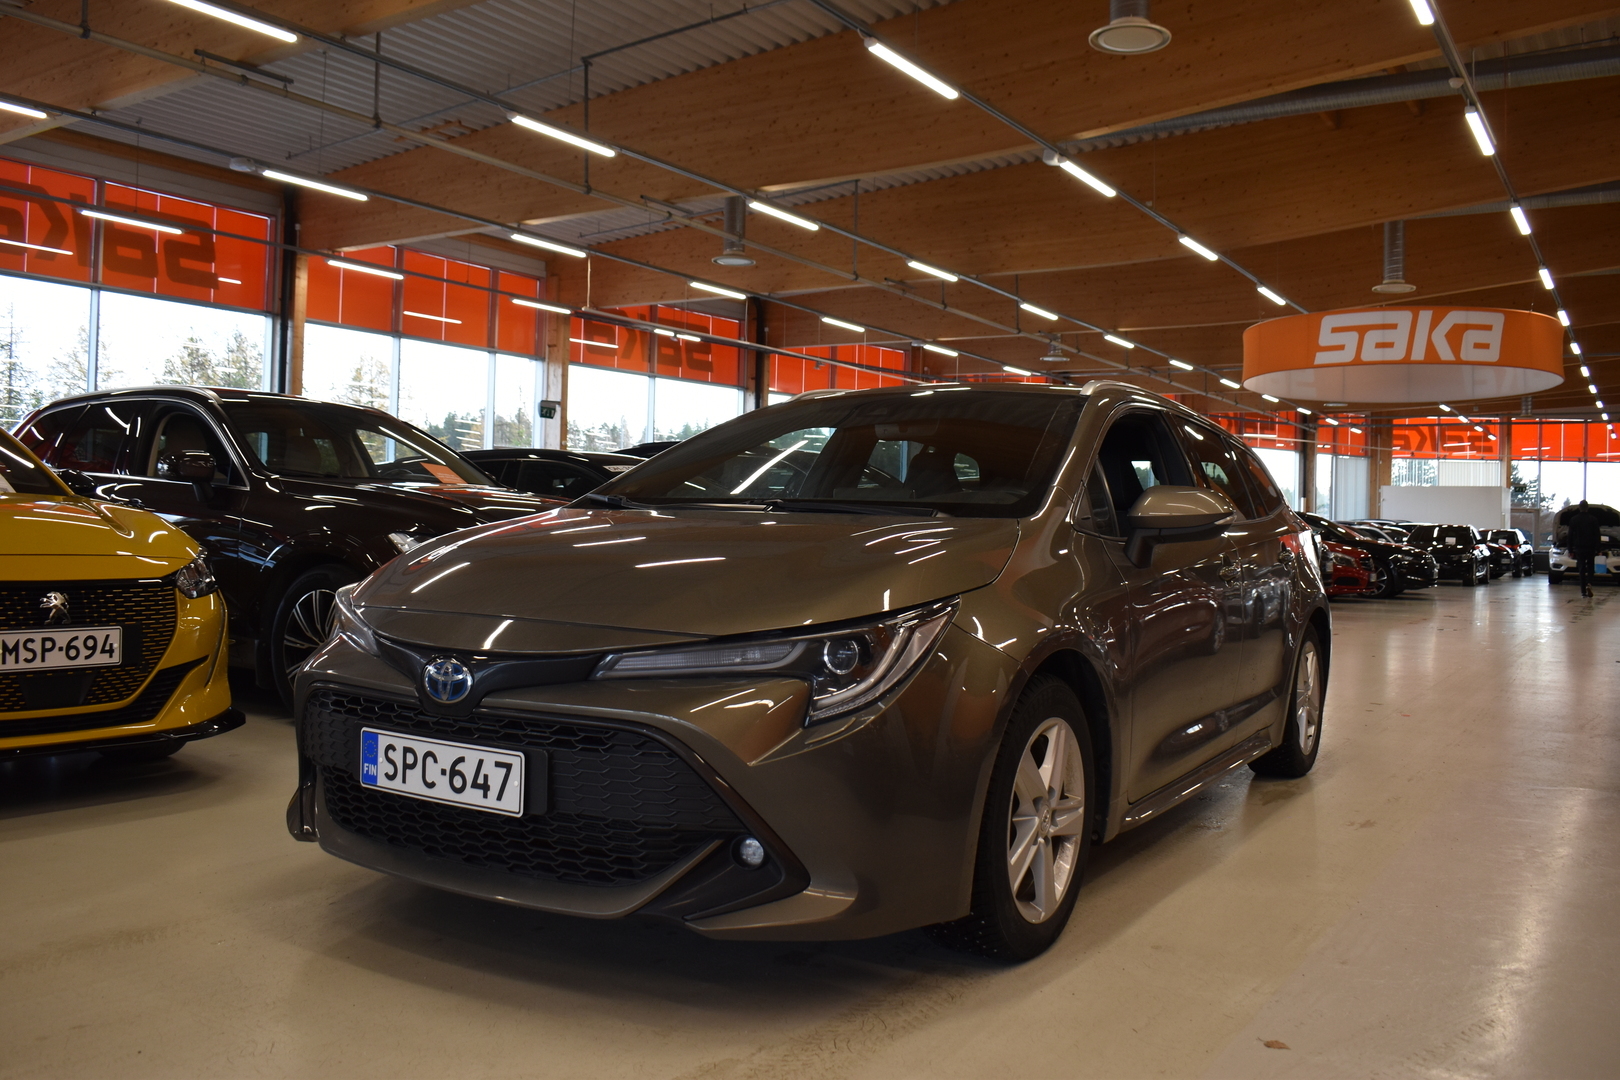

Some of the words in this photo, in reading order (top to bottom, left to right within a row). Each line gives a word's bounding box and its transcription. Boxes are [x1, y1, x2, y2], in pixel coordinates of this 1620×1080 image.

[1, 634, 115, 665] MSP-694
[363, 762, 377, 776] FIN
[384, 743, 513, 802] SPC-647
